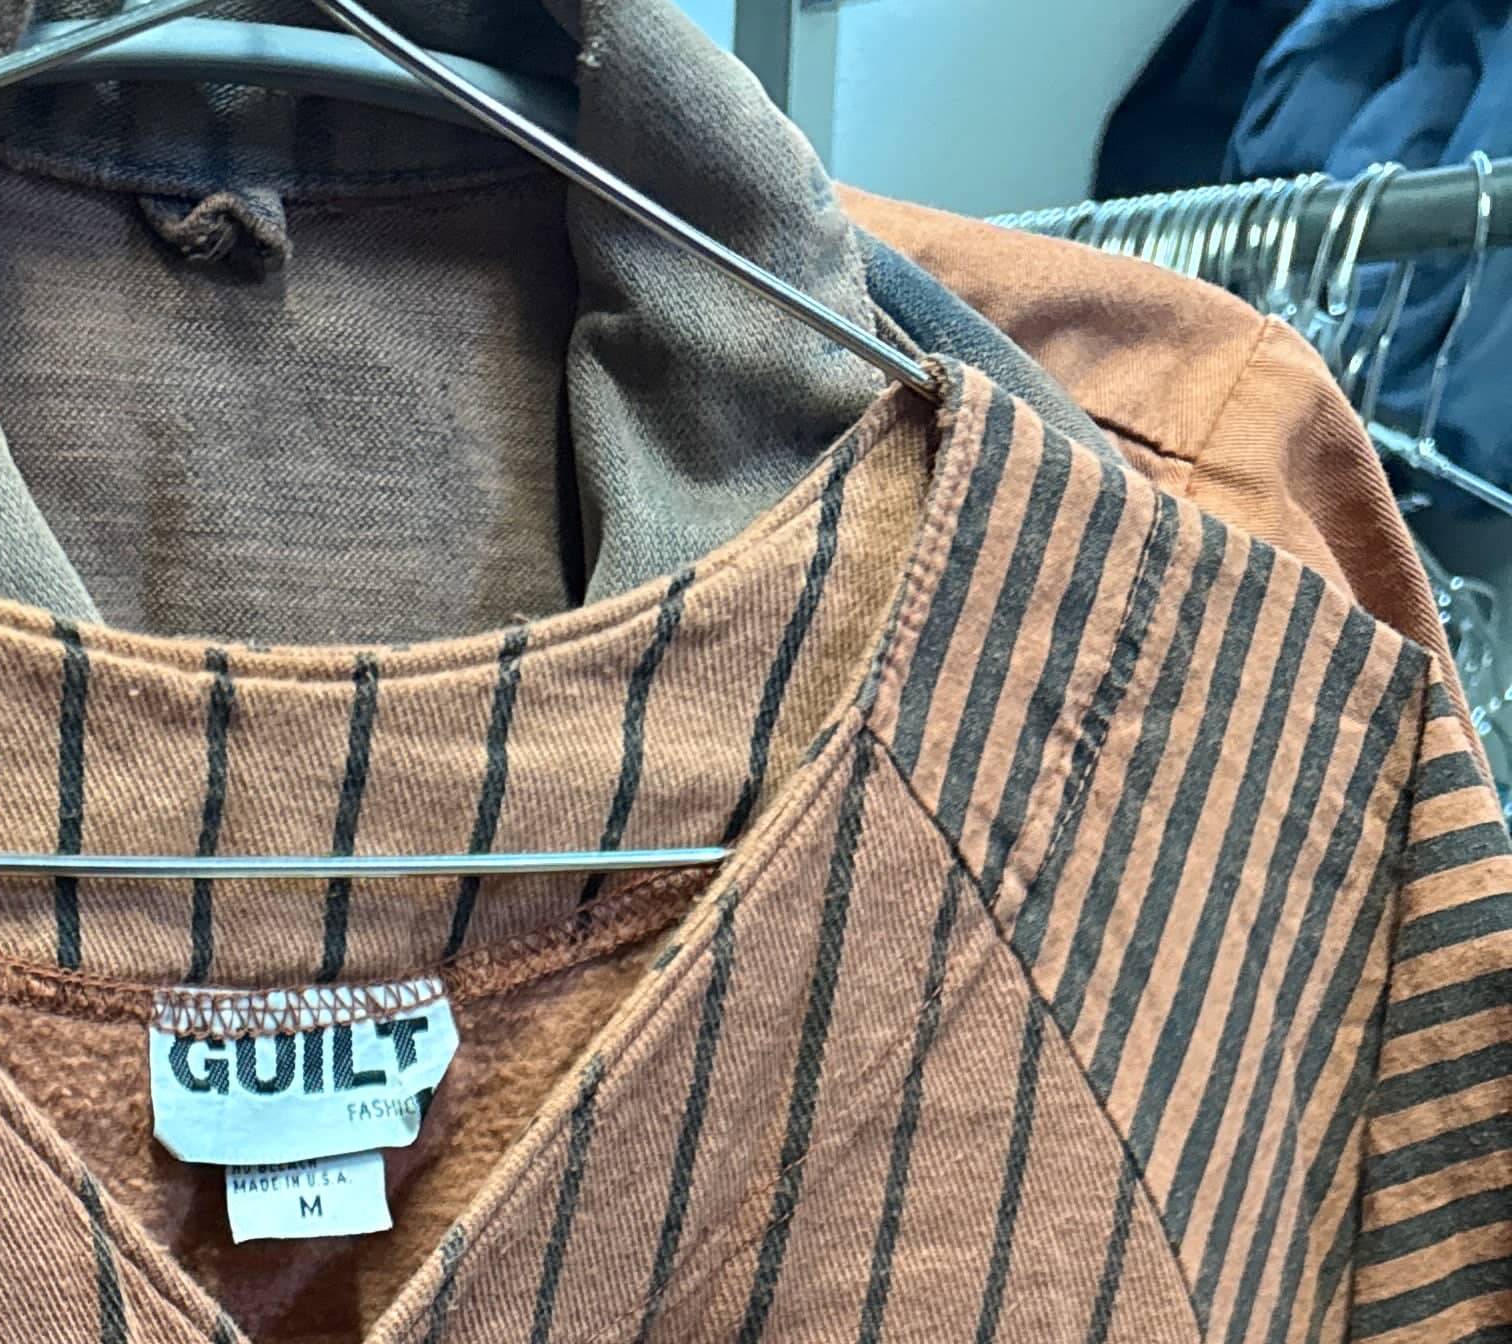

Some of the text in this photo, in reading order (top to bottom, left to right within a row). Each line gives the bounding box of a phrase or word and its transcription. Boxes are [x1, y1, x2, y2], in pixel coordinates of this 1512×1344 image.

[168, 1016, 428, 1095] GUILT
[346, 1096, 417, 1121] FASHIO
[233, 1176, 278, 1193] MADE
[285, 1175, 300, 1189] IN
[299, 1195, 323, 1218] M
